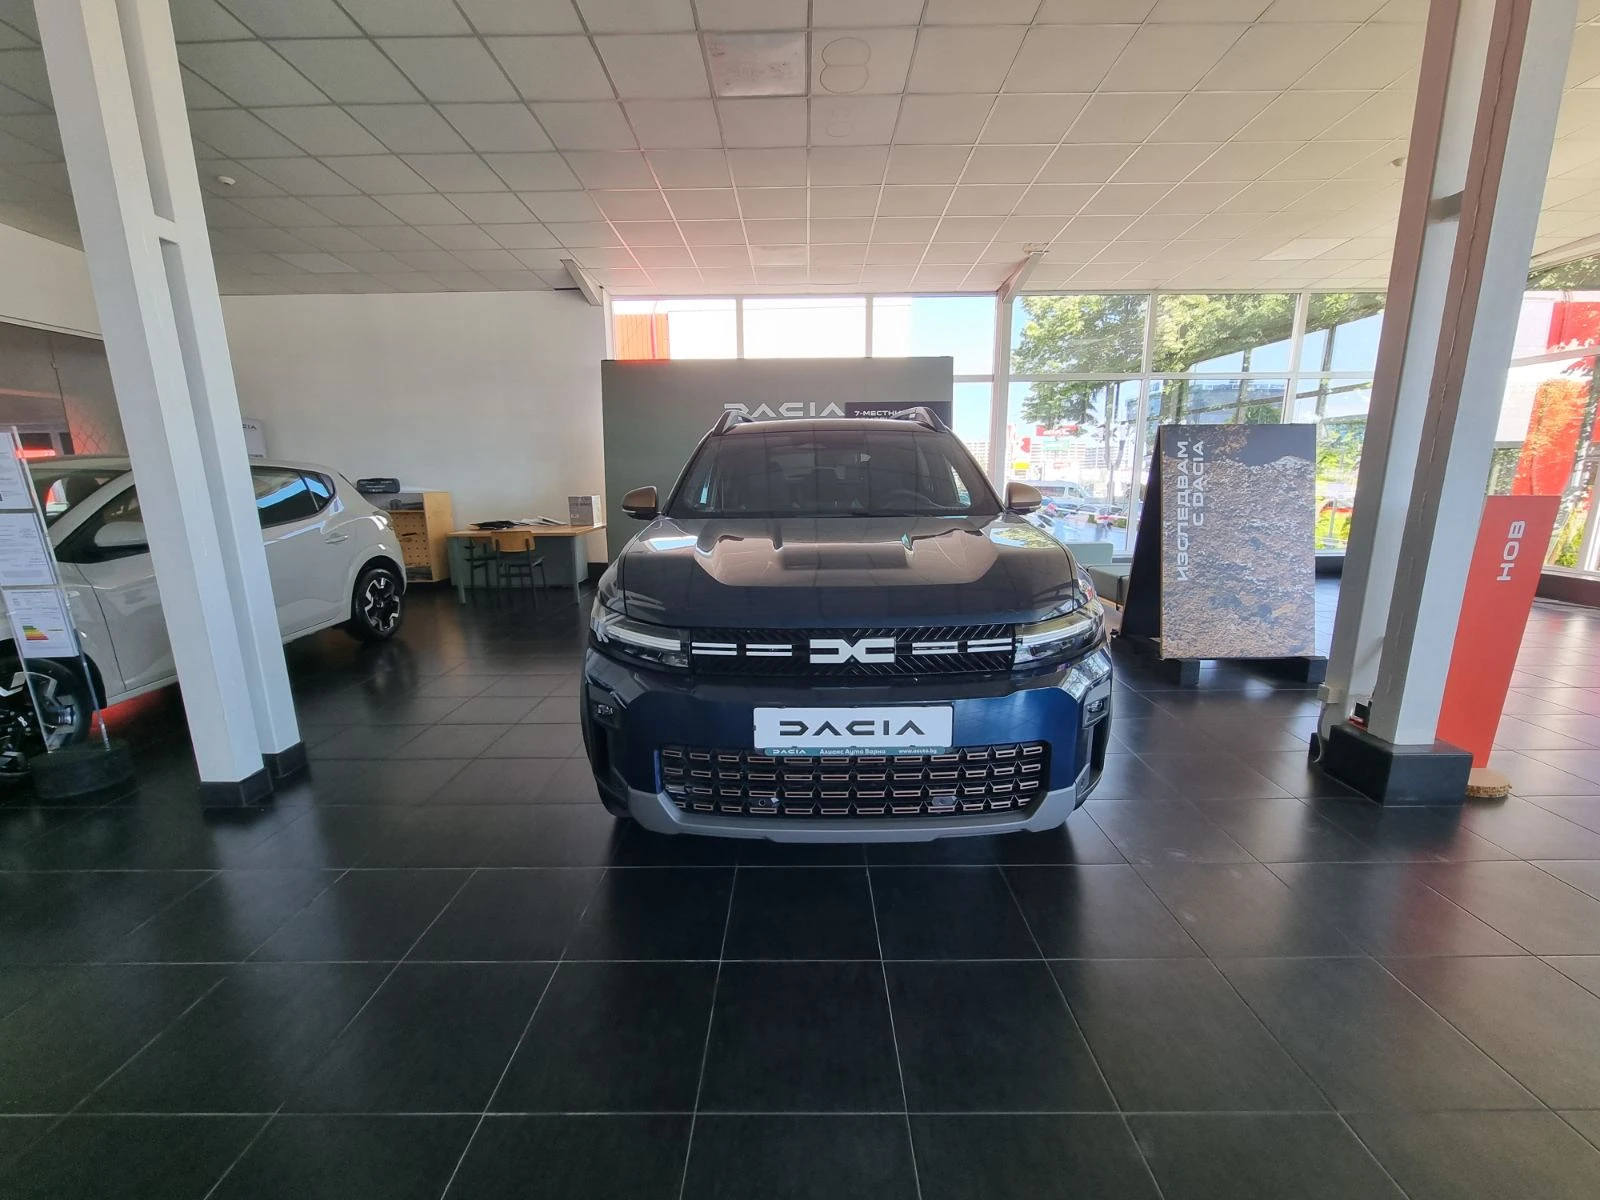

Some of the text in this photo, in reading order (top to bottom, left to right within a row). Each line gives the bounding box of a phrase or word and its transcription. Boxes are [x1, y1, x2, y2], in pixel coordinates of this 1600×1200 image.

[1193, 441, 1204, 507] DACIA
[1177, 441, 1190, 580] ИЗСЛЕДВАМ
[1496, 520, 1526, 581] НОВ
[779, 719, 925, 736] DACIA
